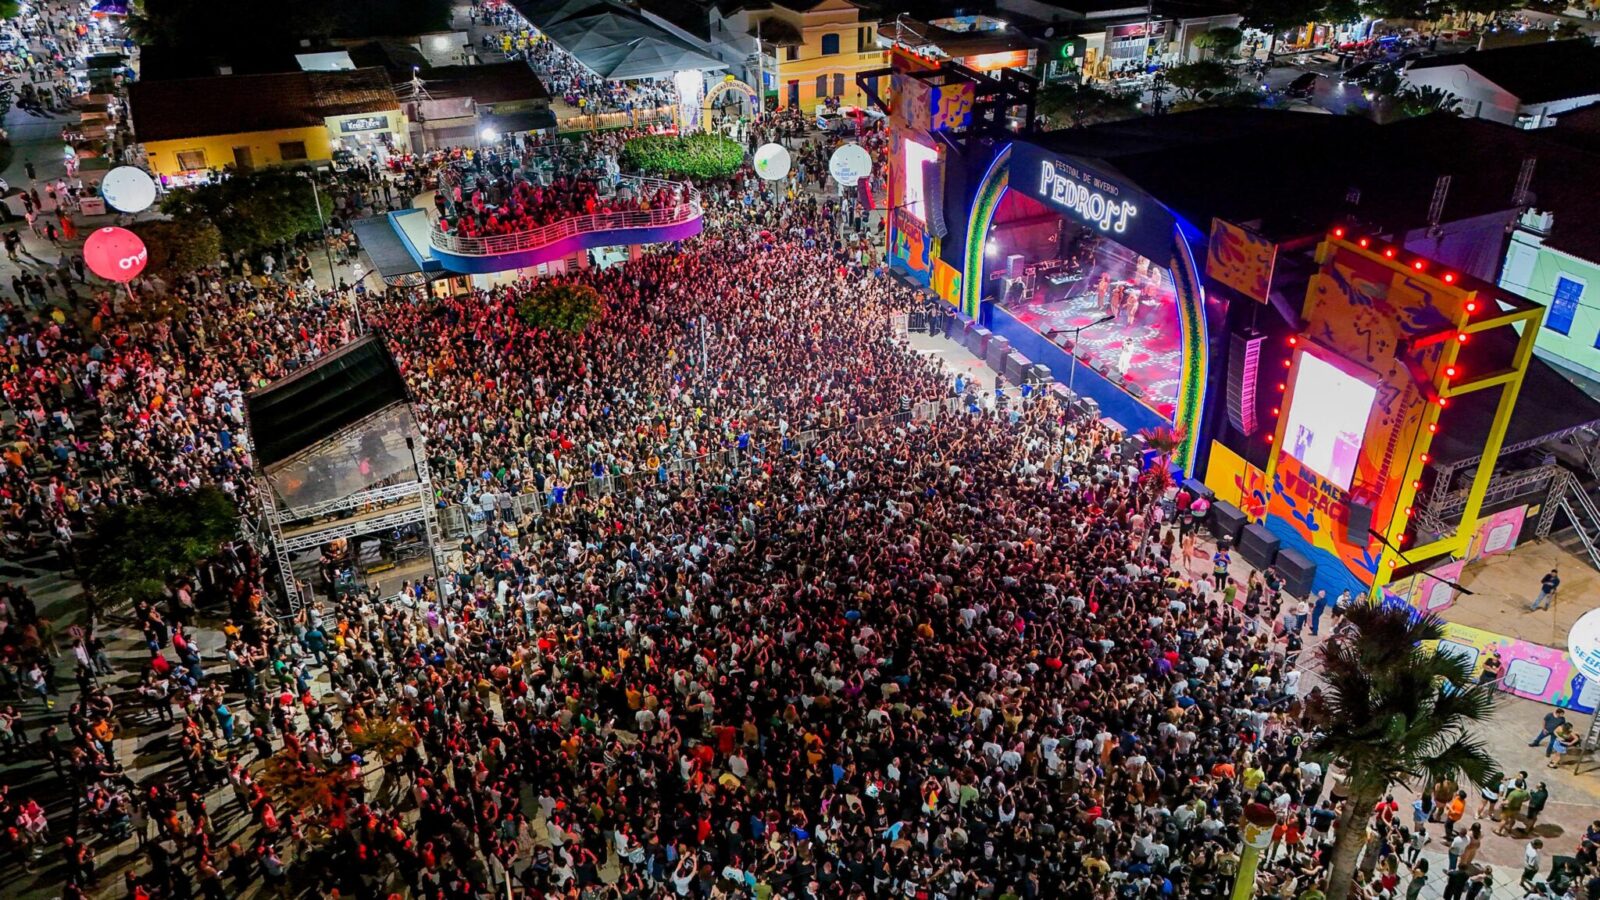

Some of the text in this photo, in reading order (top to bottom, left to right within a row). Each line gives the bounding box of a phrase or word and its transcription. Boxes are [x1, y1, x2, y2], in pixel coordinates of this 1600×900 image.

[1055, 160, 1119, 196] FESTIVAL DE INVERNO
